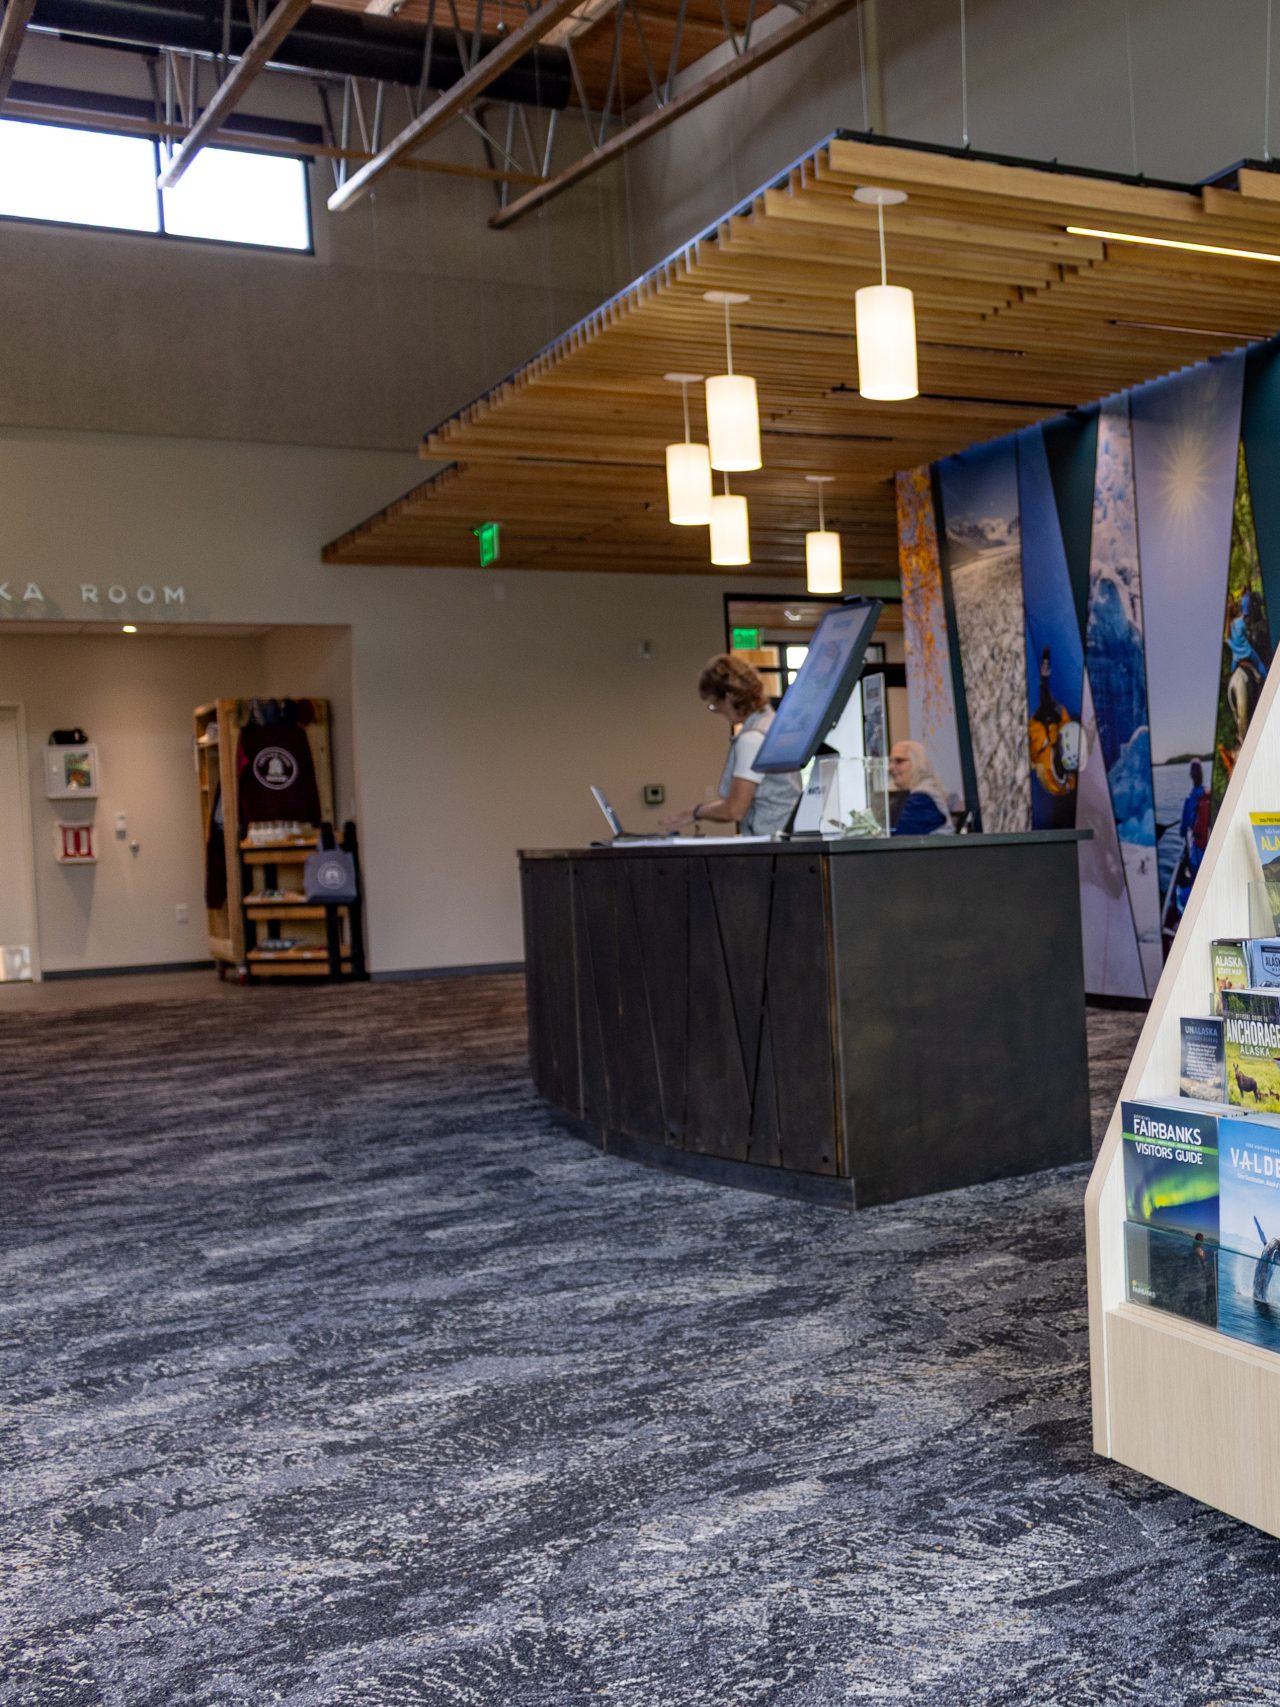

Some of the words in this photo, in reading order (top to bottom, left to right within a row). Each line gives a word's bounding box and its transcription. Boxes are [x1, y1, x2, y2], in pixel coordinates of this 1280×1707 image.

[80, 583, 187, 604] ROOM
[1215, 955, 1244, 968] ALASKA
[1185, 1025, 1218, 1036] UNALASKA
[1240, 1044, 1271, 1057] ALASKA
[1133, 1118, 1202, 1145] FAIRBANKS
[1135, 1142, 1173, 1160] VISITORS
[1175, 1150, 1204, 1165] GUIDE
